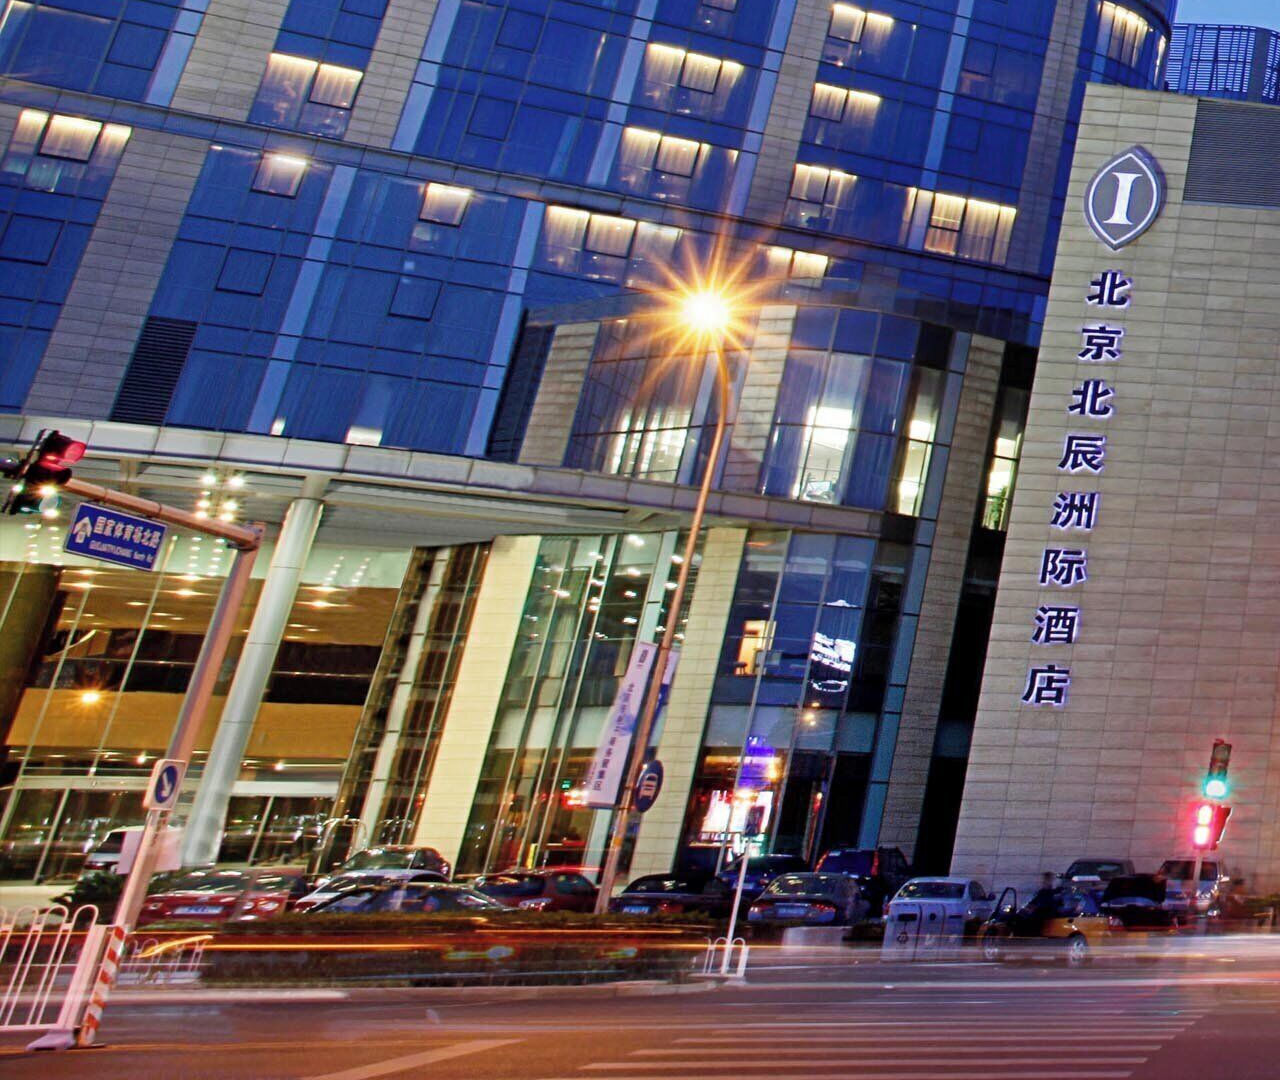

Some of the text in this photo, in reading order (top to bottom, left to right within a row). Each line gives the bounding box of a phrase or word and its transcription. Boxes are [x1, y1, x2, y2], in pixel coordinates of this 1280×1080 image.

[93, 516, 161, 549] 国家体育场北路
[1022, 270, 1131, 705] 北京北辰洲际酒店
